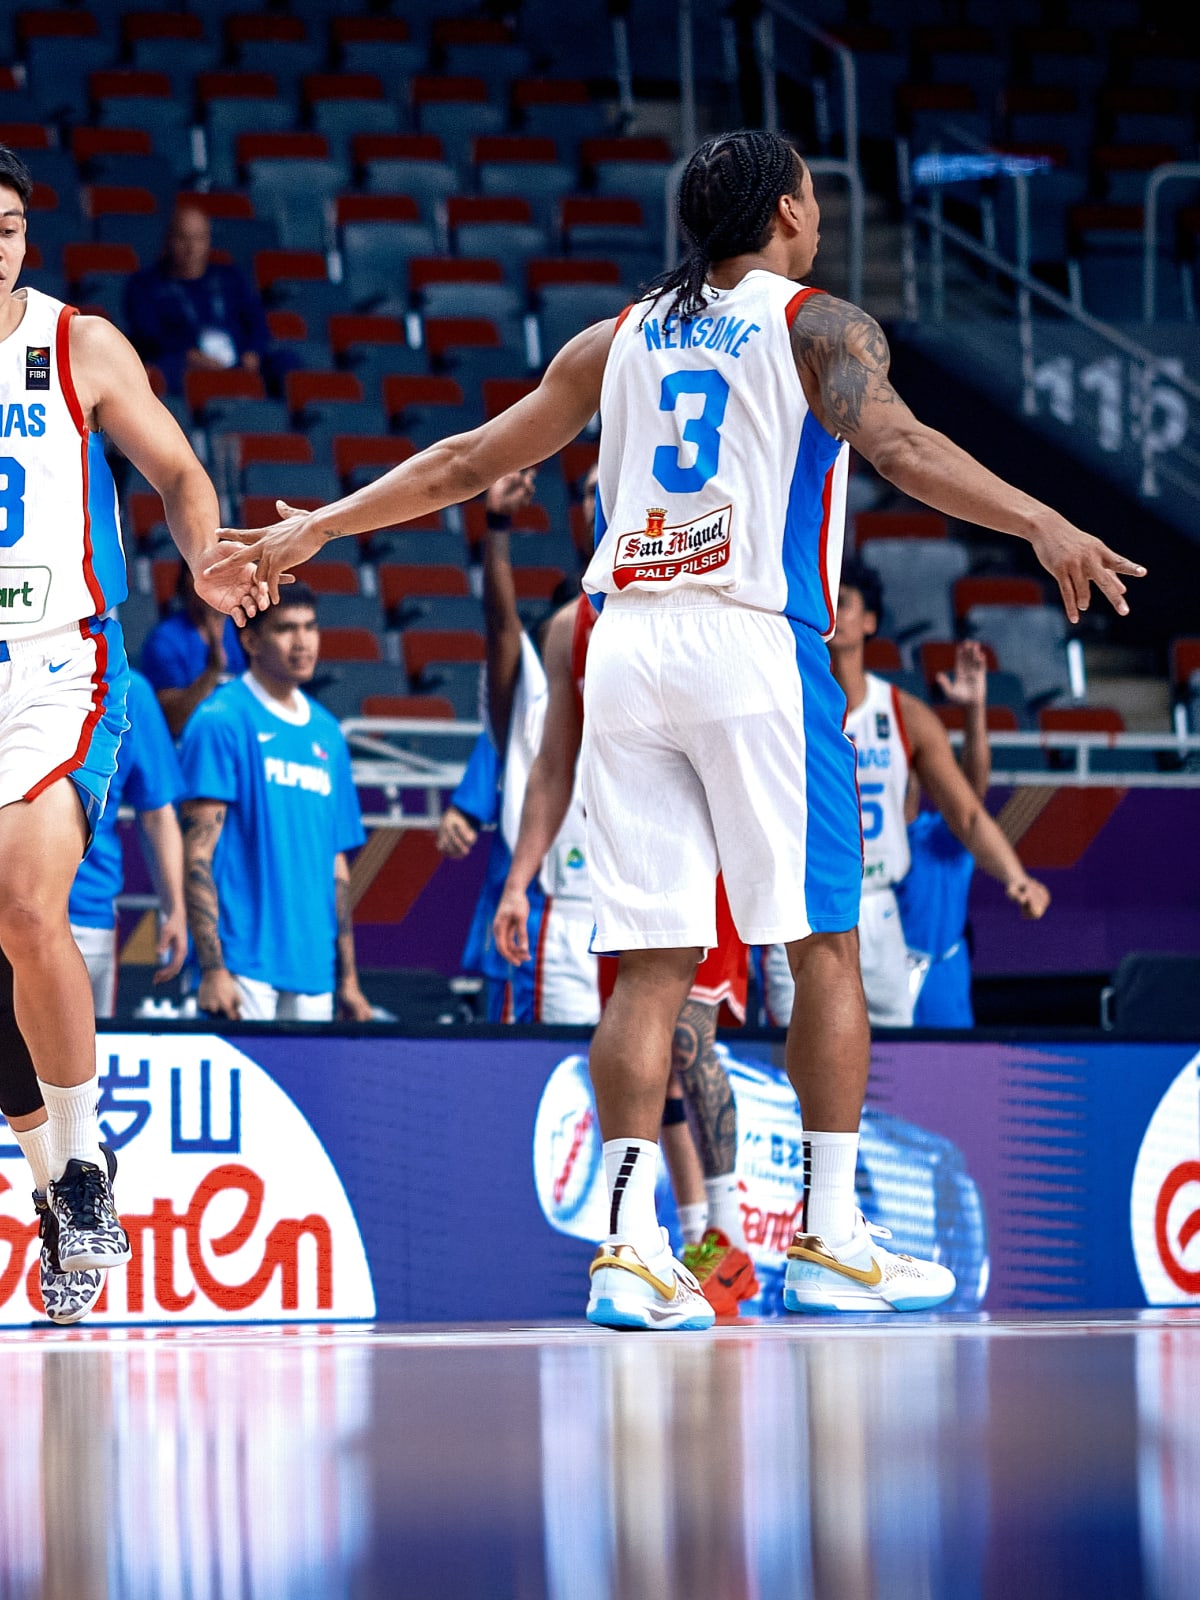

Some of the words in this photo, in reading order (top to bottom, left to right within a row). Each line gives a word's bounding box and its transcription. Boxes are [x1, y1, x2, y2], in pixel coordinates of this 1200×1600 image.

[643, 315, 761, 358] NEWSOME
[29, 370, 47, 379] FIBA
[652, 369, 730, 493] 3
[622, 538, 664, 560] San
[634, 566, 676, 578] PALE
[680, 549, 726, 574] PILSEN
